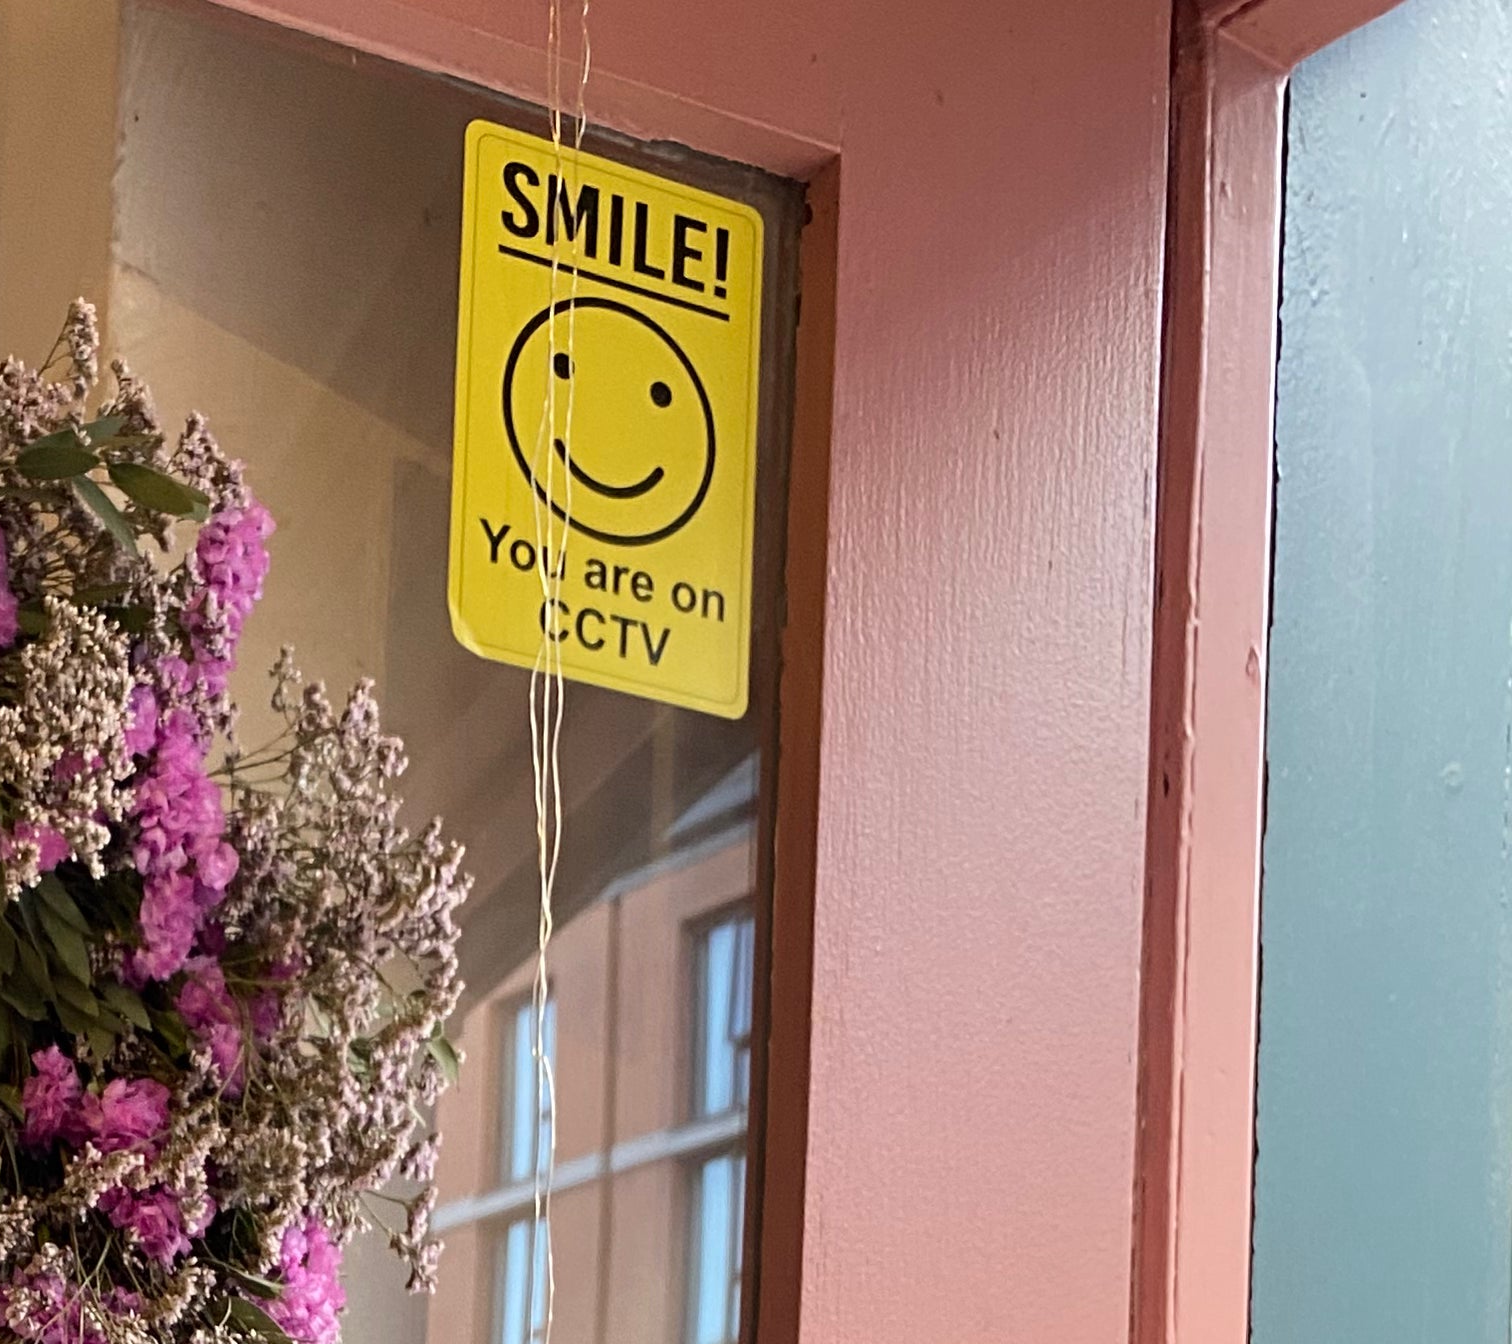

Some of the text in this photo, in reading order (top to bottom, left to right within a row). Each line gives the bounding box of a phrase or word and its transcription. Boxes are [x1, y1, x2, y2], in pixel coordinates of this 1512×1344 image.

[501, 161, 729, 299] SMILE!
[479, 518, 725, 622] You are on
[540, 598, 671, 667] CCTV
